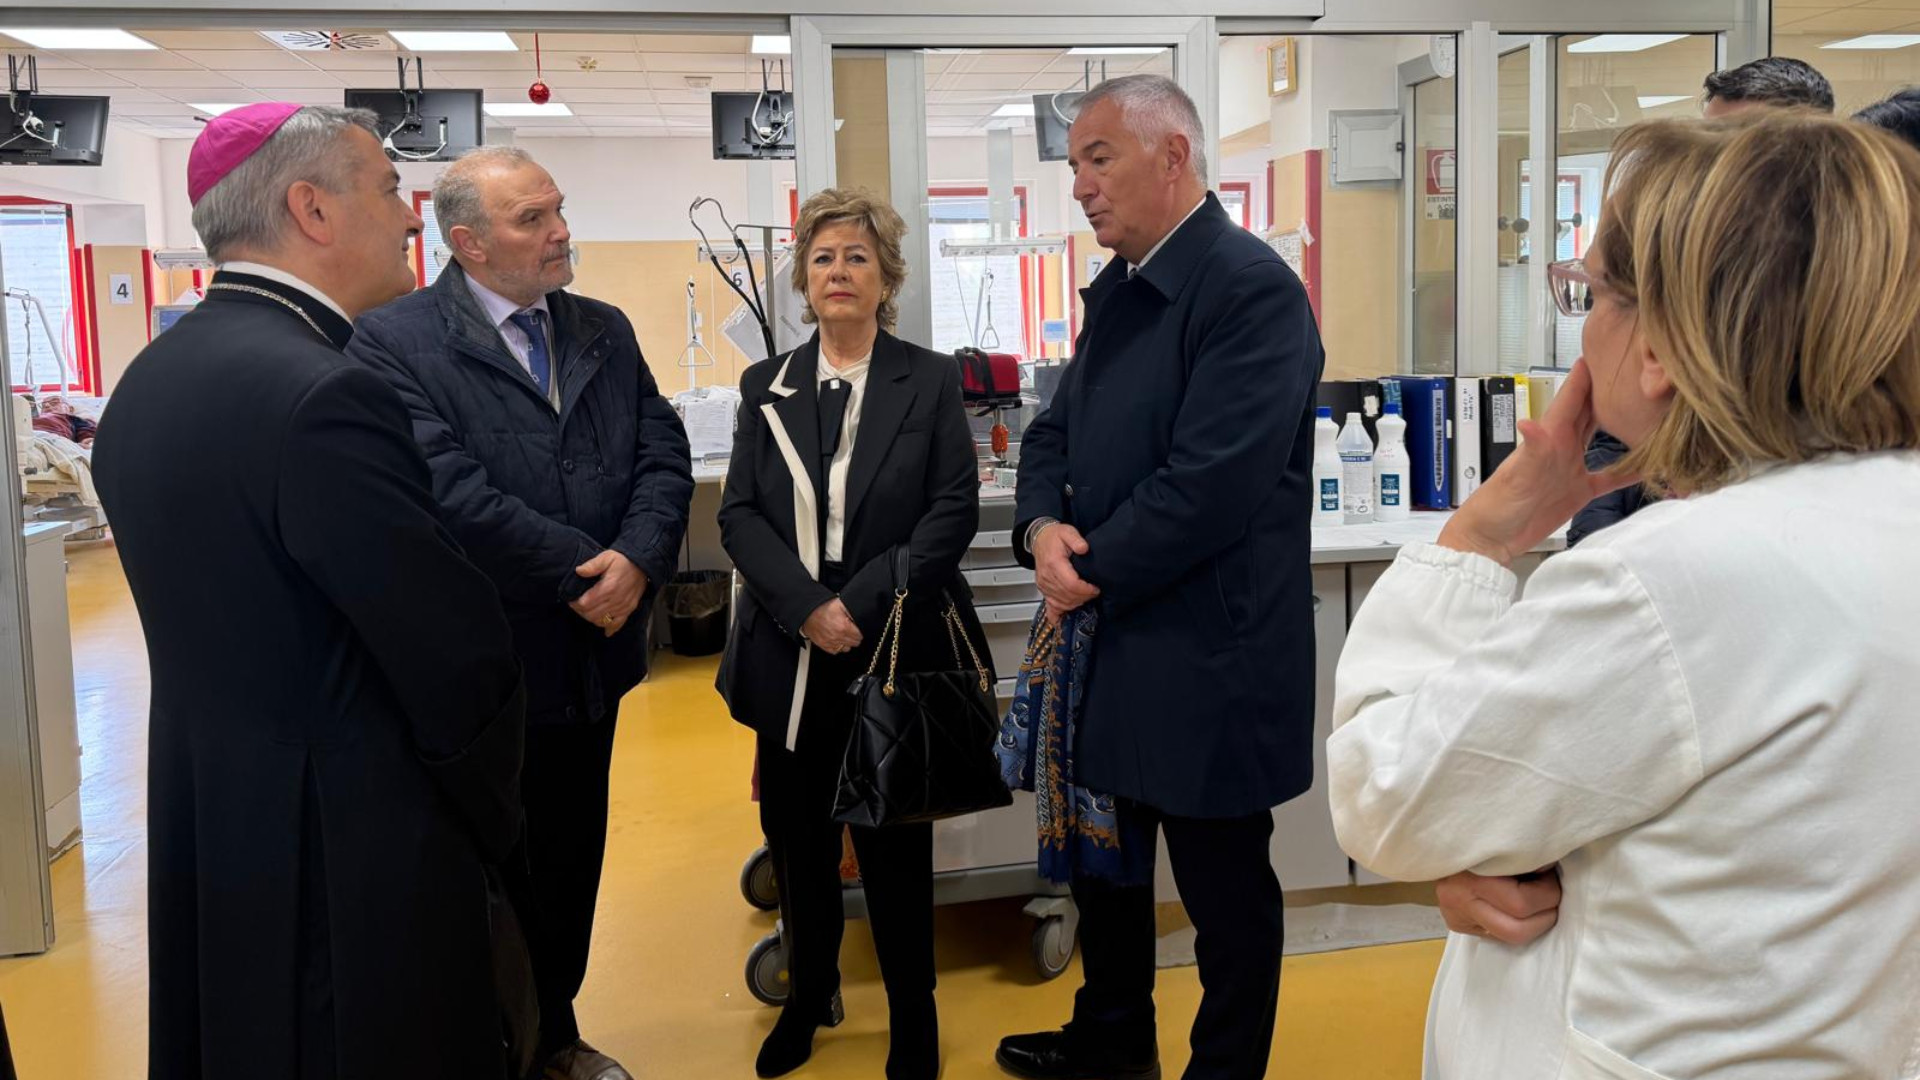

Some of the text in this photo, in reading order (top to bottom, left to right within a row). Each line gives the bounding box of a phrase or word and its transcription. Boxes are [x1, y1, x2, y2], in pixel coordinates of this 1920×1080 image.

[1092, 261, 1101, 275] 7
[732, 271, 743, 287] 6
[116, 282, 129, 299] 4
